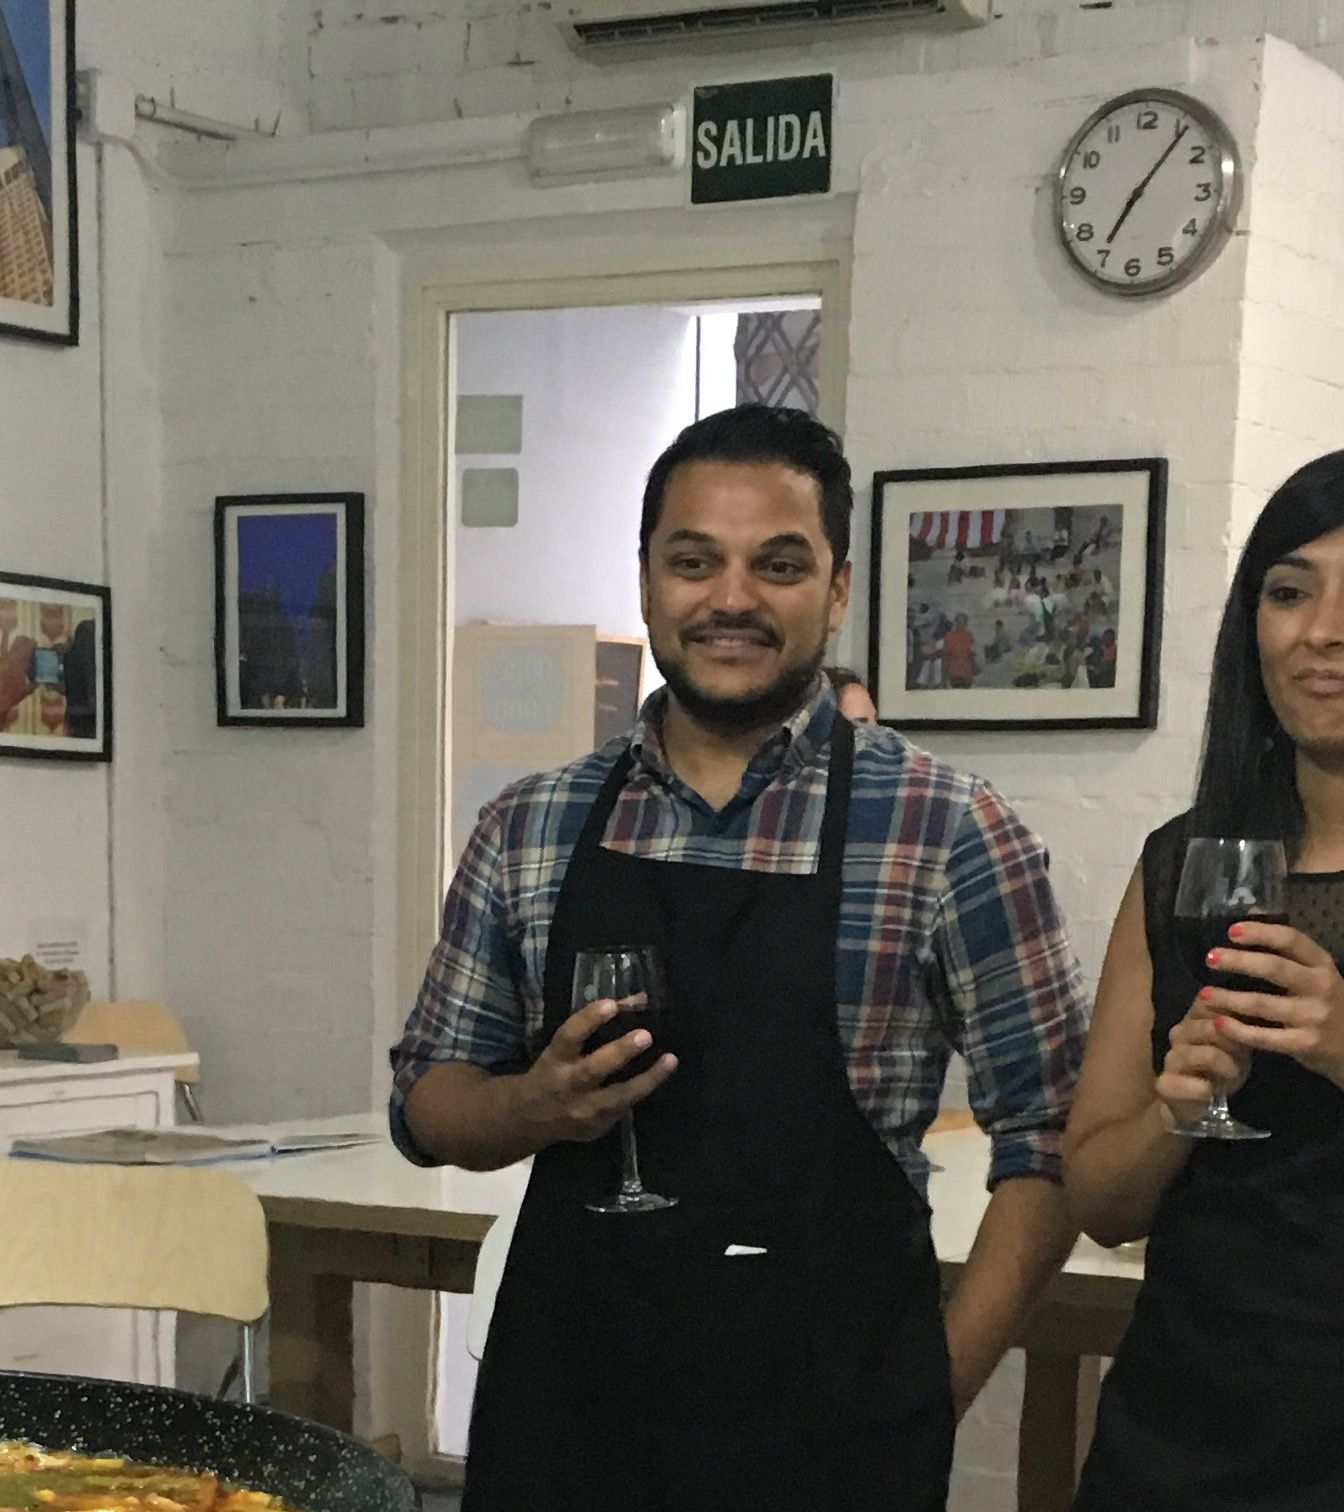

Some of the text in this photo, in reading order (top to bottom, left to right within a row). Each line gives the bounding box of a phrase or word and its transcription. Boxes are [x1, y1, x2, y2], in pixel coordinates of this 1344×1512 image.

[1136, 111, 1159, 130] 12
[696, 109, 827, 169] SALIDA
[1107, 125, 1121, 144] 11
[1083, 150, 1101, 169] 10
[1188, 146, 1206, 164] 2
[1070, 186, 1087, 205] 9
[1193, 183, 1212, 202] 3
[1076, 222, 1095, 242] 8
[1182, 218, 1198, 236] 4
[1097, 249, 1111, 268] 7
[1156, 246, 1175, 266] 5
[1124, 258, 1142, 277] 6
